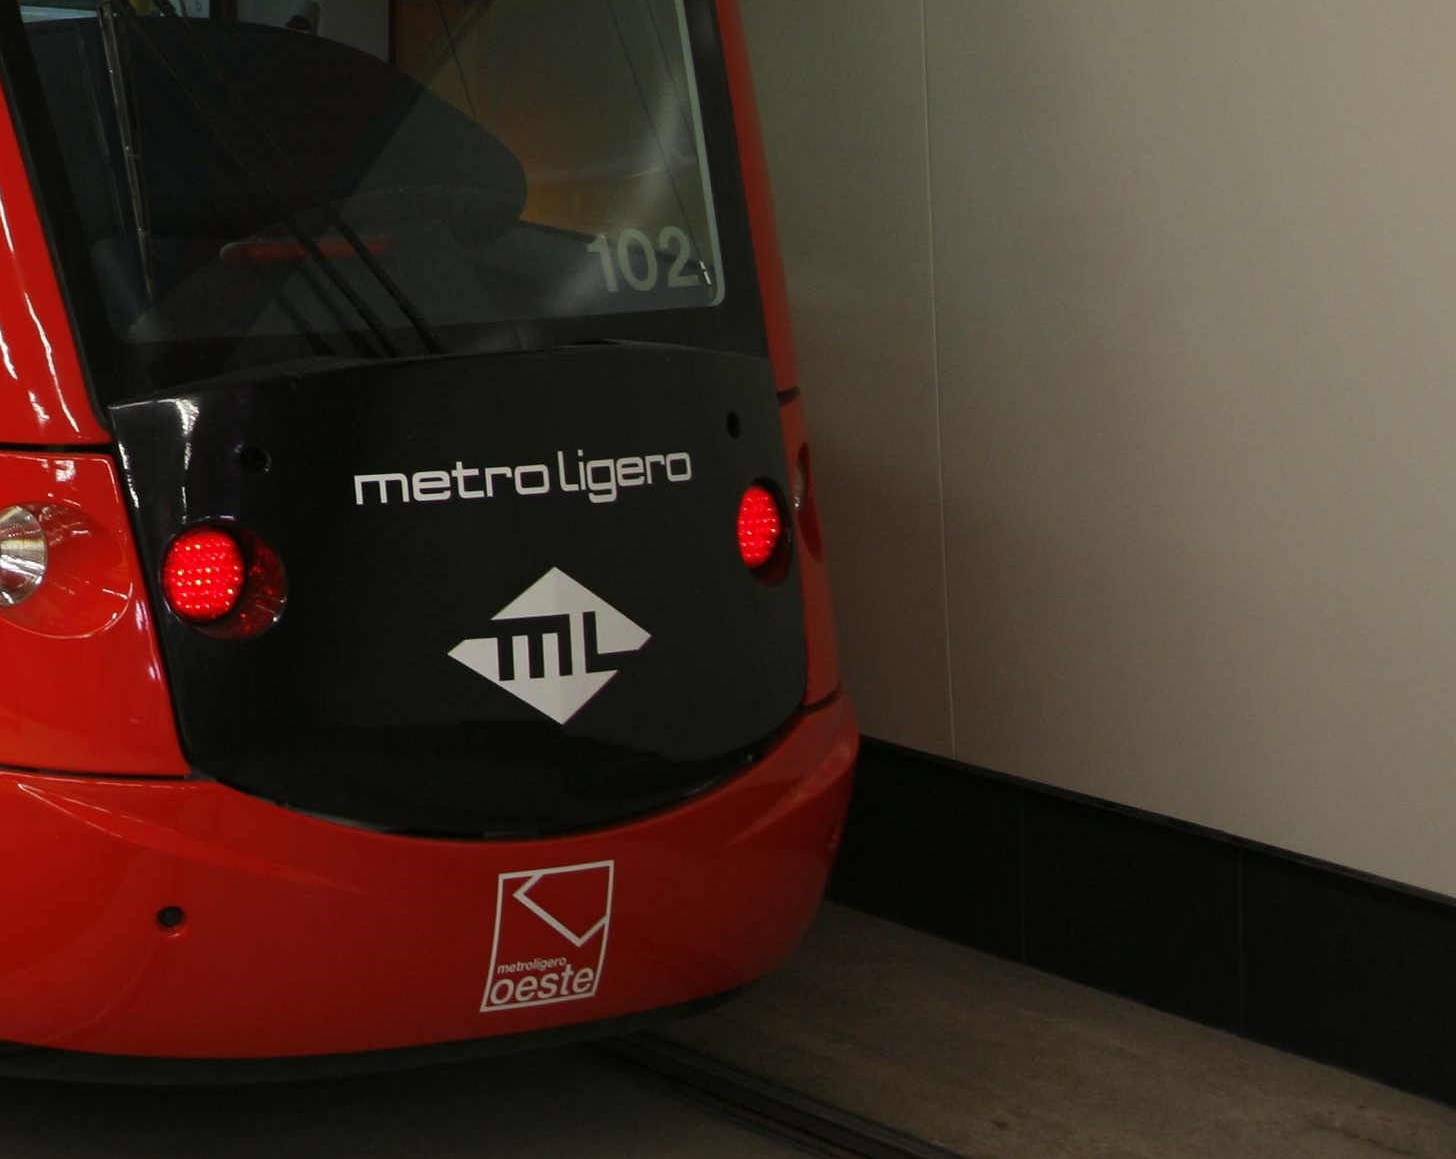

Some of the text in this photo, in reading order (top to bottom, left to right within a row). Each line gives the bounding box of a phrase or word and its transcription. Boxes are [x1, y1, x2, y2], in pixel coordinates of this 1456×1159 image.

[586, 225, 700, 293] 102
[353, 461, 550, 505] metro
[489, 963, 594, 1005] oeste
[497, 956, 567, 974] metroligero
